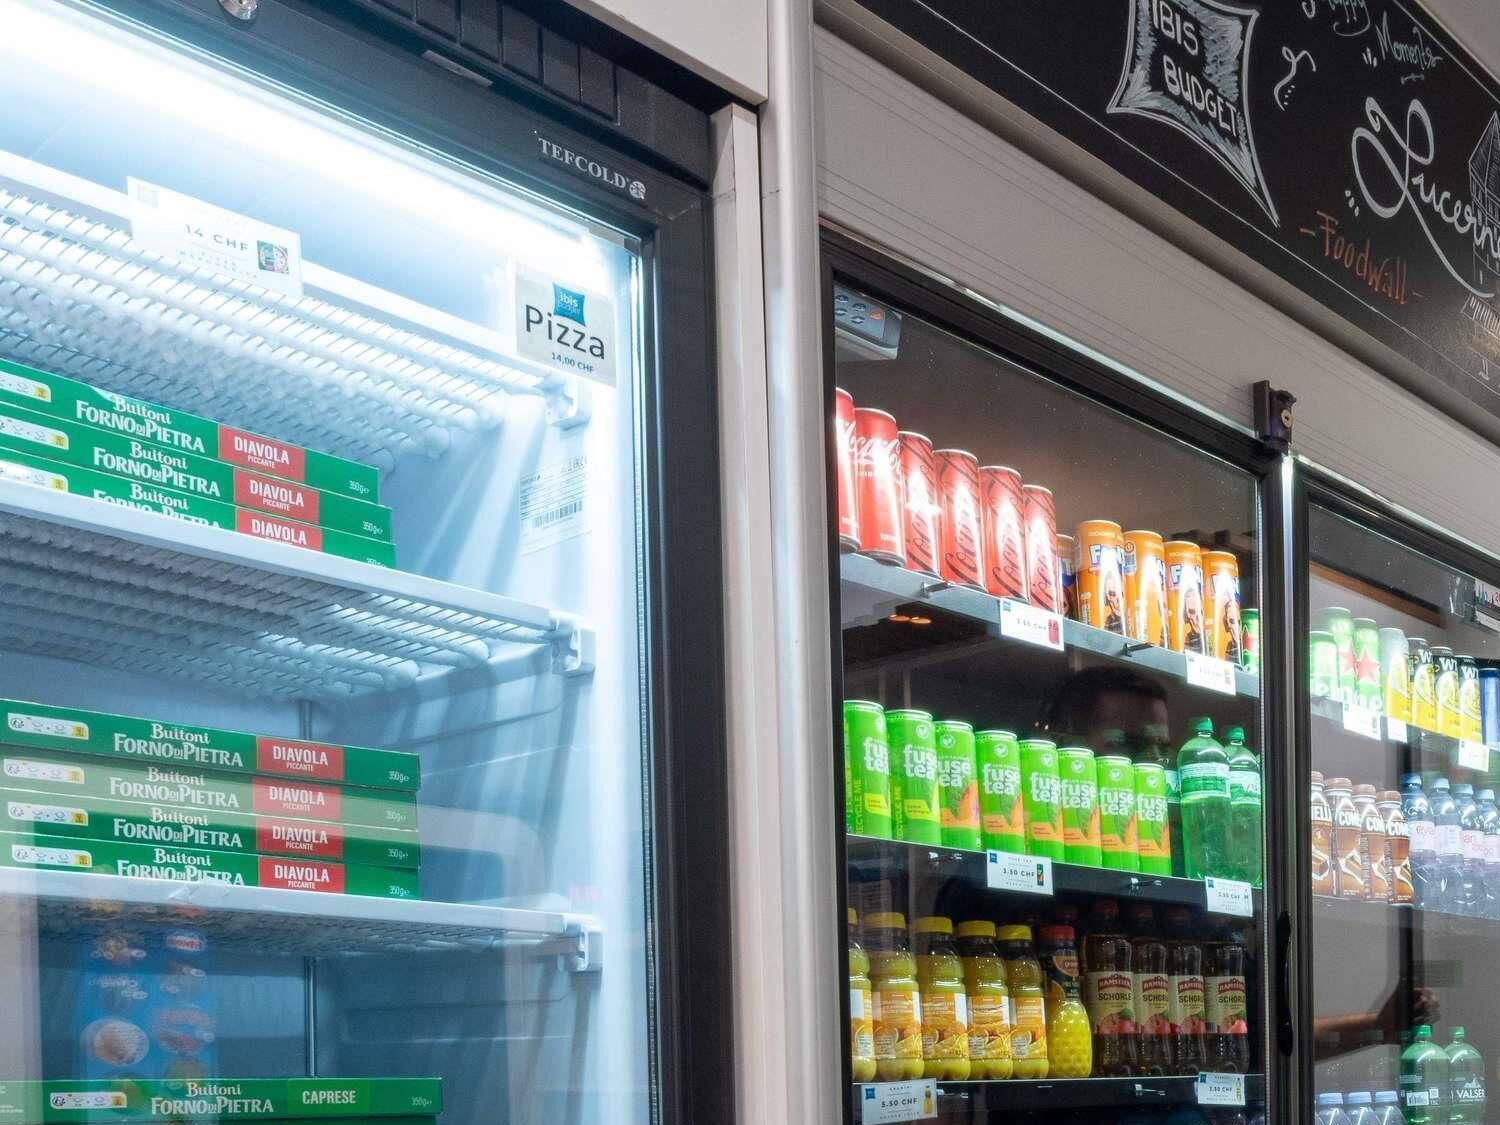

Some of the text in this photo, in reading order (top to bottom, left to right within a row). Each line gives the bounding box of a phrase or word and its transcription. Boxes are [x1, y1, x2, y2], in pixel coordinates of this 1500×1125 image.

[1163, 55, 1238, 136] BUDGET
[538, 138, 627, 188] TEFCOLD
[186, 224, 248, 251] 14 CHF
[1317, 210, 1409, 304] Foodwall
[560, 292, 578, 308] ibis
[526, 304, 605, 360] Pizza
[578, 362, 594, 374] CHF
[110, 395, 172, 425] Buitoni
[129, 442, 187, 469] Buitoni
[234, 437, 289, 465] DIAVOLA
[248, 456, 275, 469] PICCANTE
[129, 483, 189, 510] Buitoni
[250, 480, 304, 507] DIAVOLA
[263, 500, 290, 512] PICCANTE
[252, 519, 307, 546] DIAVOLA
[151, 724, 210, 745] Buitoni
[273, 746, 328, 766] DIAVOLA
[904, 745, 938, 761] fus
[286, 762, 314, 772] PICCANTE
[937, 759, 971, 774] use
[147, 767, 205, 787] Buitoni
[939, 772, 962, 787] ea
[1030, 773, 1060, 790] fus
[984, 780, 1015, 795] tea
[1031, 788, 1060, 803] tea
[1062, 780, 1096, 796] fuse
[270, 786, 325, 806] DIAVOLA
[1062, 793, 1090, 808] tea
[283, 802, 311, 812] PICCANTE
[1100, 801, 1129, 815] tea
[1138, 806, 1164, 821] tea
[150, 807, 209, 827] Buitoni
[273, 826, 328, 846] DIAVOLA
[286, 842, 314, 851] PICCANTE
[154, 848, 211, 867] Buitoni
[275, 865, 330, 883] DIAVOLA
[288, 880, 315, 889] PICCANTE
[1099, 992, 1131, 1000] SCHORLE
[187, 1082, 241, 1098] Buitoni
[302, 1090, 356, 1105] CAPRESE
[1456, 1088, 1485, 1098] VALSER
[901, 1098, 919, 1106] CHF
